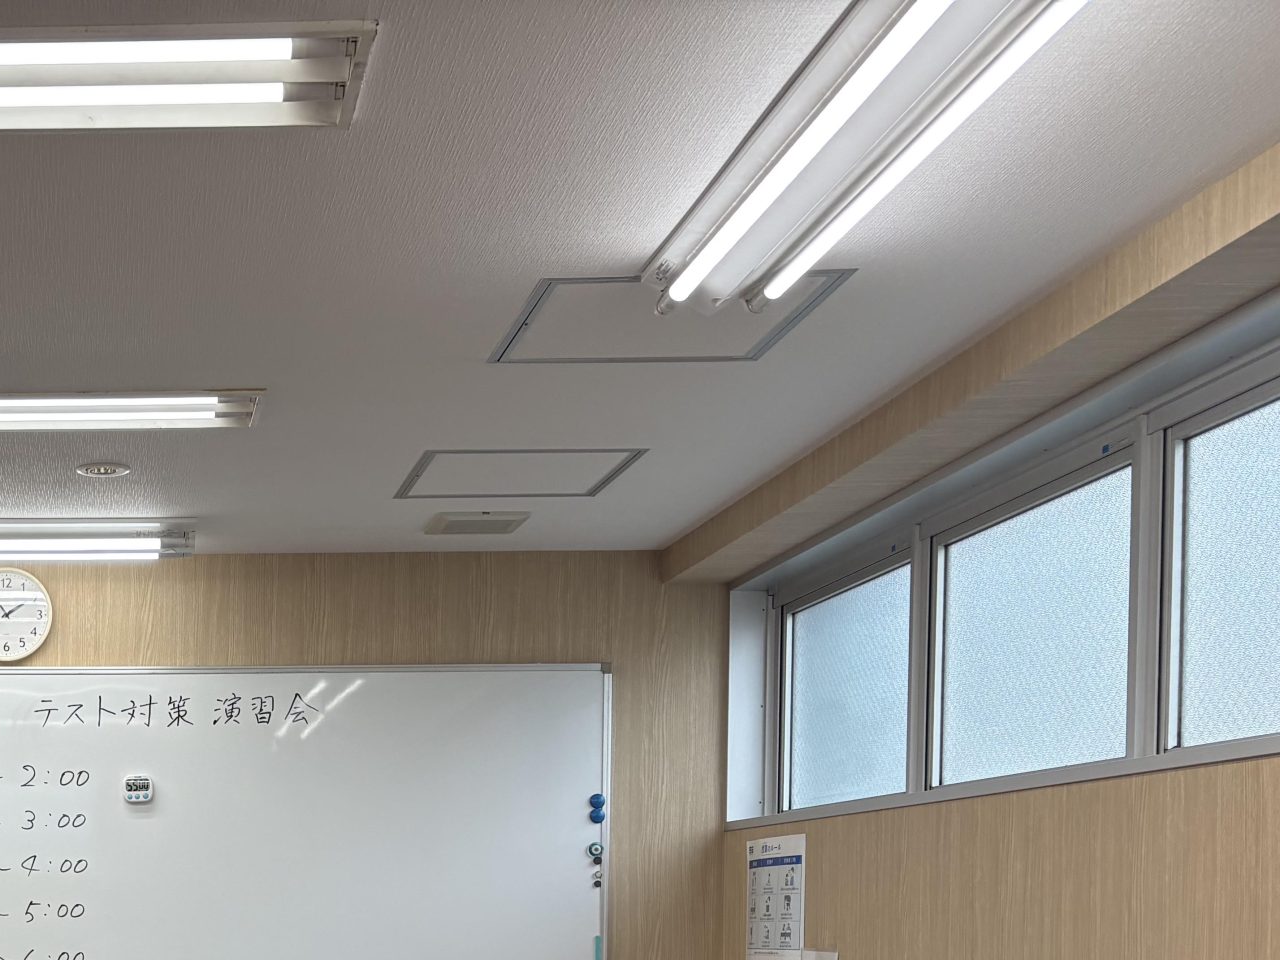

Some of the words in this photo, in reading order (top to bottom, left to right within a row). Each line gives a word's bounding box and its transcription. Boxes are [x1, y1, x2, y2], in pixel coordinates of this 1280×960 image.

[0, 578, 12, 588] 12
[36, 609, 43, 620] 3
[30, 627, 37, 637] 4
[3, 642, 10, 652] 6
[19, 637, 26, 648] 5
